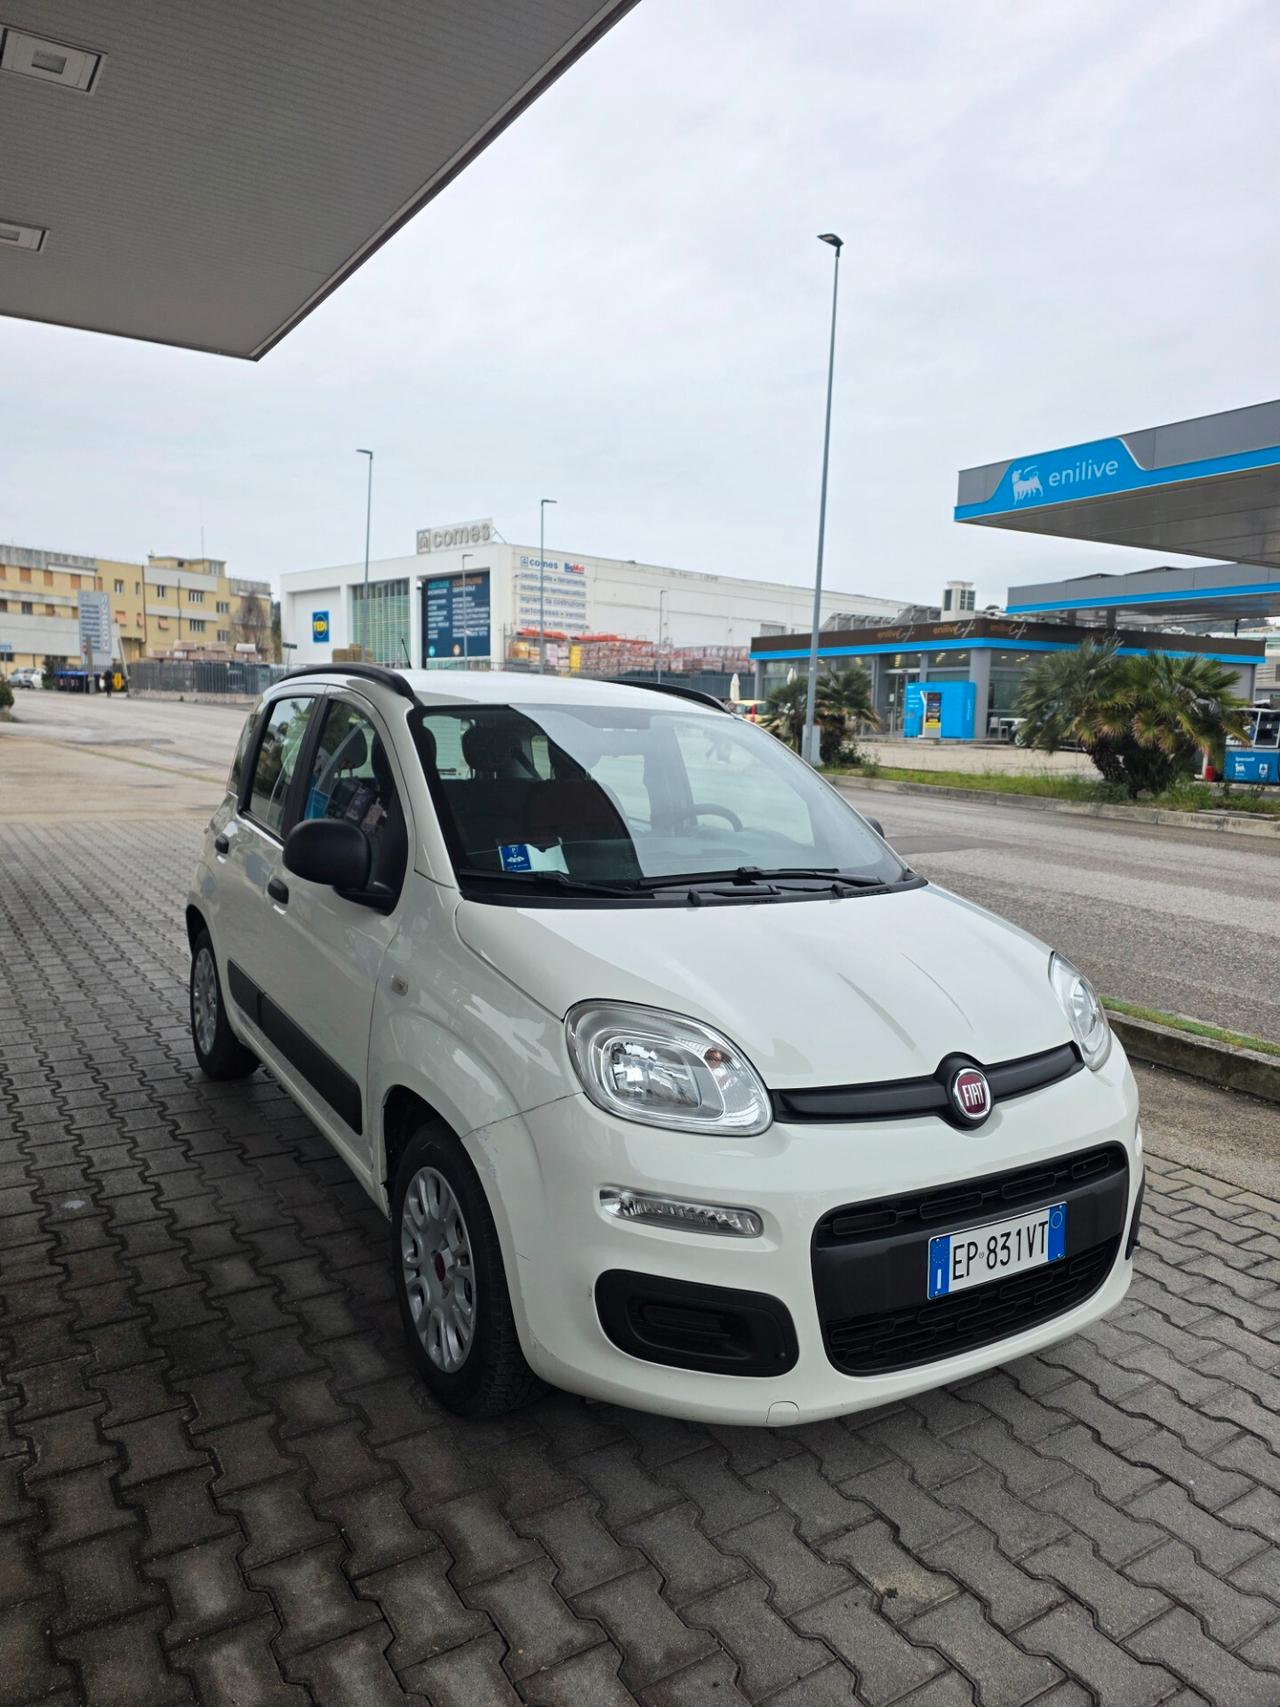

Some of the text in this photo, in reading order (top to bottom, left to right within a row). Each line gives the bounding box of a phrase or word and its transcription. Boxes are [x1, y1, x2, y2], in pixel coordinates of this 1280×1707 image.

[1048, 459, 1119, 488] enilive
[433, 523, 491, 548] comes
[529, 559, 559, 570] comes
[961, 1082, 985, 1107] FIAT
[952, 1221, 1049, 1281] EP 831VT
